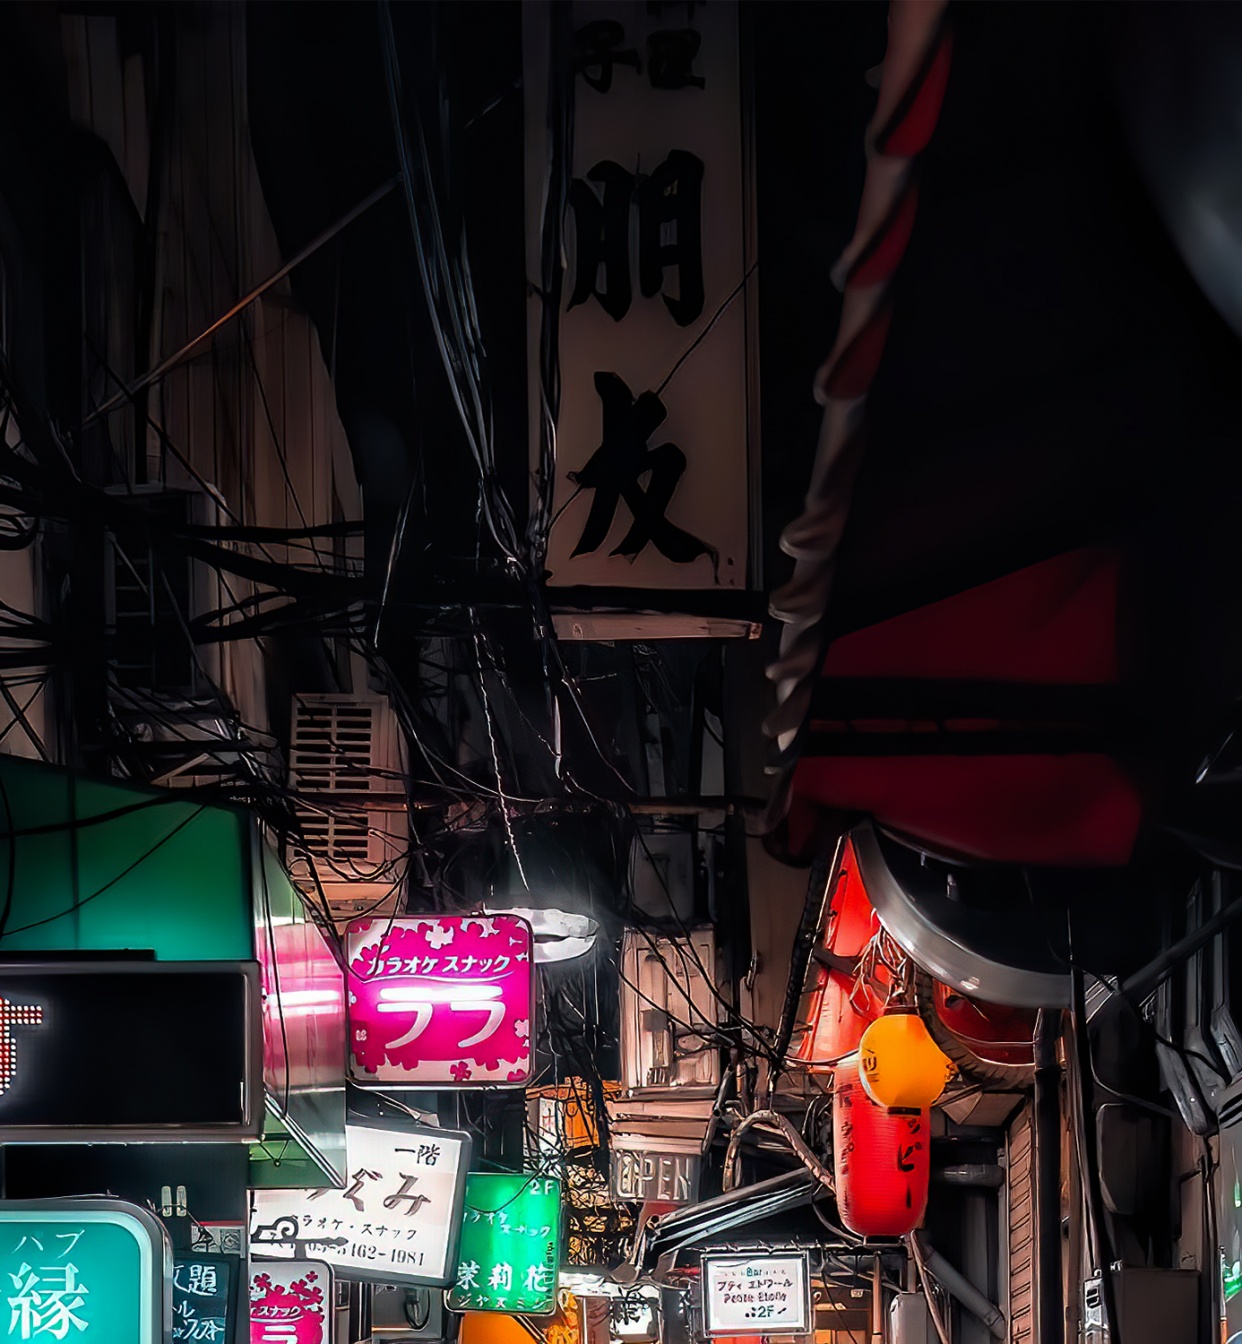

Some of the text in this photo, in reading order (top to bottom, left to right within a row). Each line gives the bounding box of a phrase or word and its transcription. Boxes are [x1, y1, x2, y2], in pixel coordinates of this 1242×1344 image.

[366, 955, 511, 975] カラオケ スナック
[376, 985, 507, 1049] ララ
[305, 1167, 432, 1217] ぐみ
[7, 1261, 90, 1340] 縁
